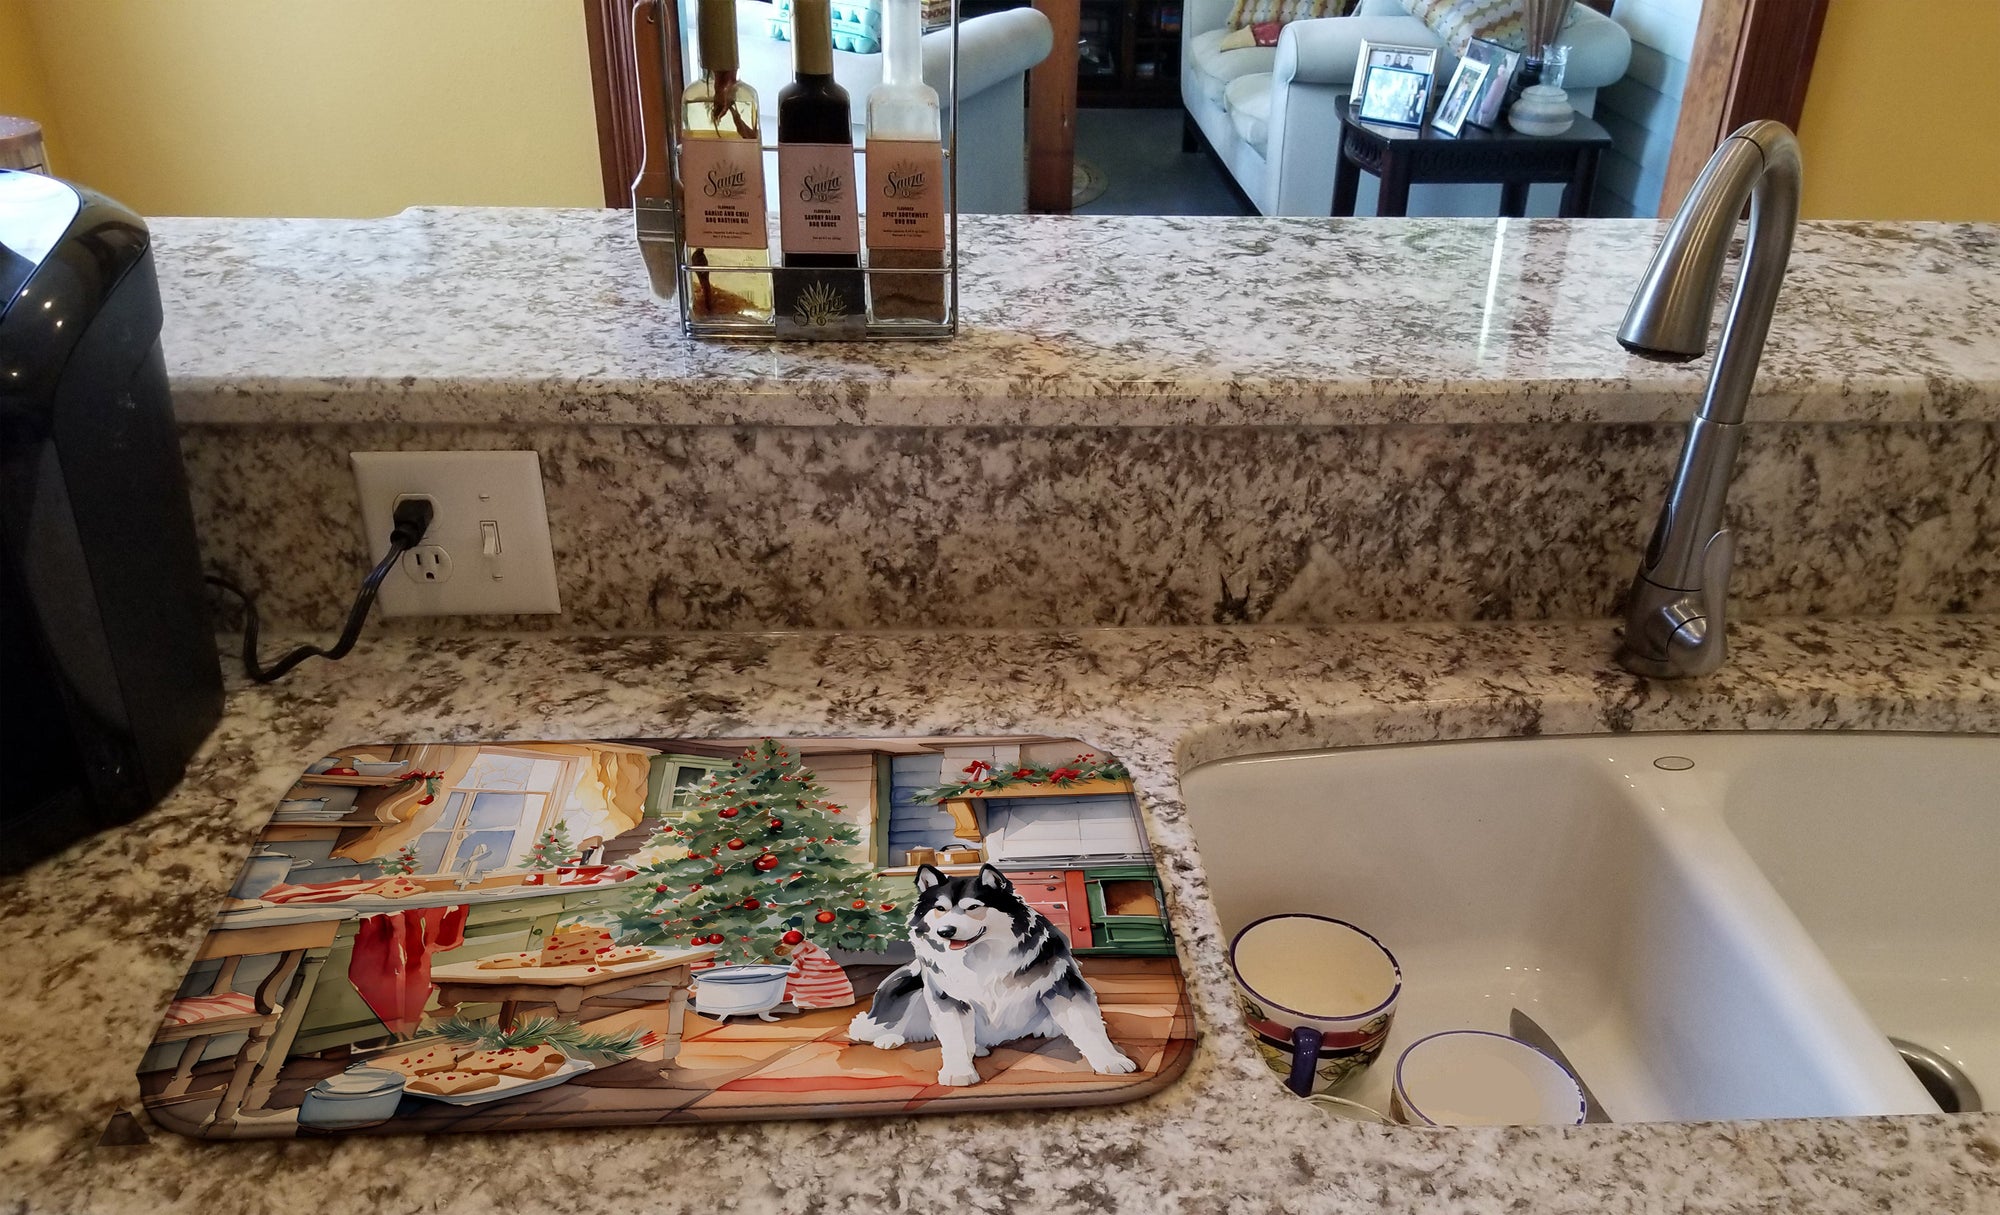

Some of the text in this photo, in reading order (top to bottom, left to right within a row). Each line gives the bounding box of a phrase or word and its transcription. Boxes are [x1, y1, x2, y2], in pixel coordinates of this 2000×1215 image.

[703, 169, 745, 197] Sauza
[799, 175, 842, 202] Sauza
[883, 171, 926, 198] Sauza
